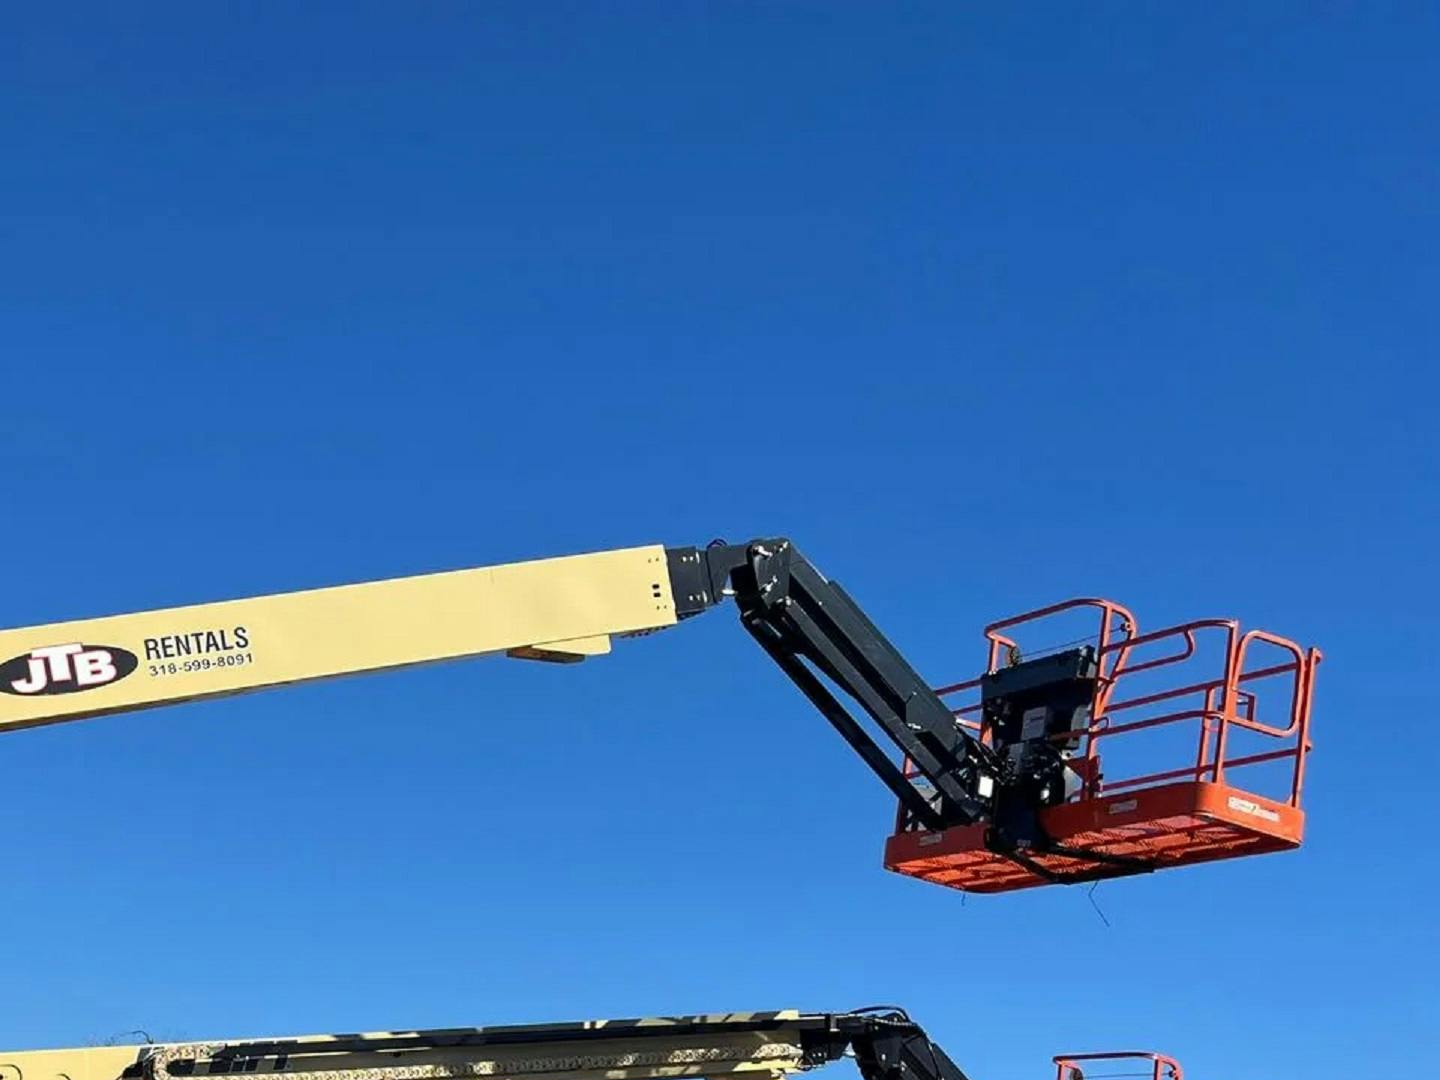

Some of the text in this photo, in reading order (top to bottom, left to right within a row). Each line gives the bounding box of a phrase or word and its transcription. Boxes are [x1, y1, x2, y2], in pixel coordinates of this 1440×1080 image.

[11, 626, 252, 695] JTB RENTALS
[148, 651, 254, 677] 318-599-8091
